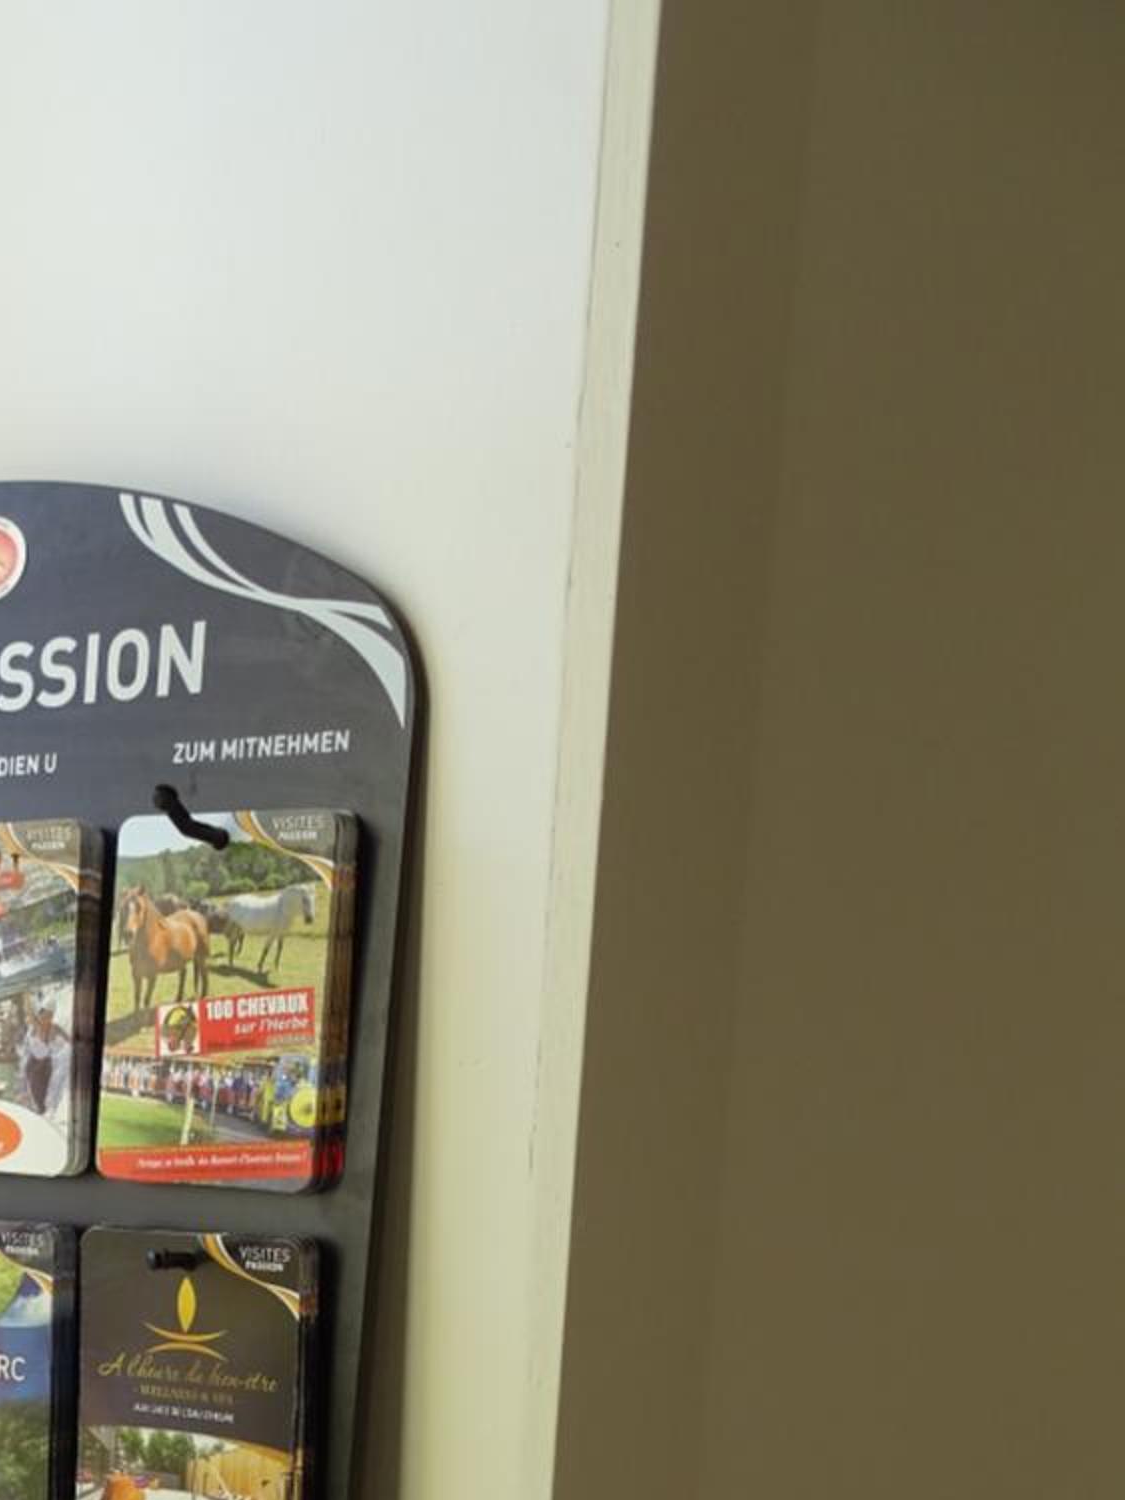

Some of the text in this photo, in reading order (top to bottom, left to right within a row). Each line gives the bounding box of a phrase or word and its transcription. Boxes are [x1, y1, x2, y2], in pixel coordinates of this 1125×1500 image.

[172, 730, 350, 764] ZUM MITNEHMEN
[40, 753, 57, 774] U
[271, 814, 325, 831] VISITES
[206, 992, 309, 1020] 100 CHEVAUX
[235, 1022, 257, 1035] sur
[239, 1245, 292, 1264] VISITES
